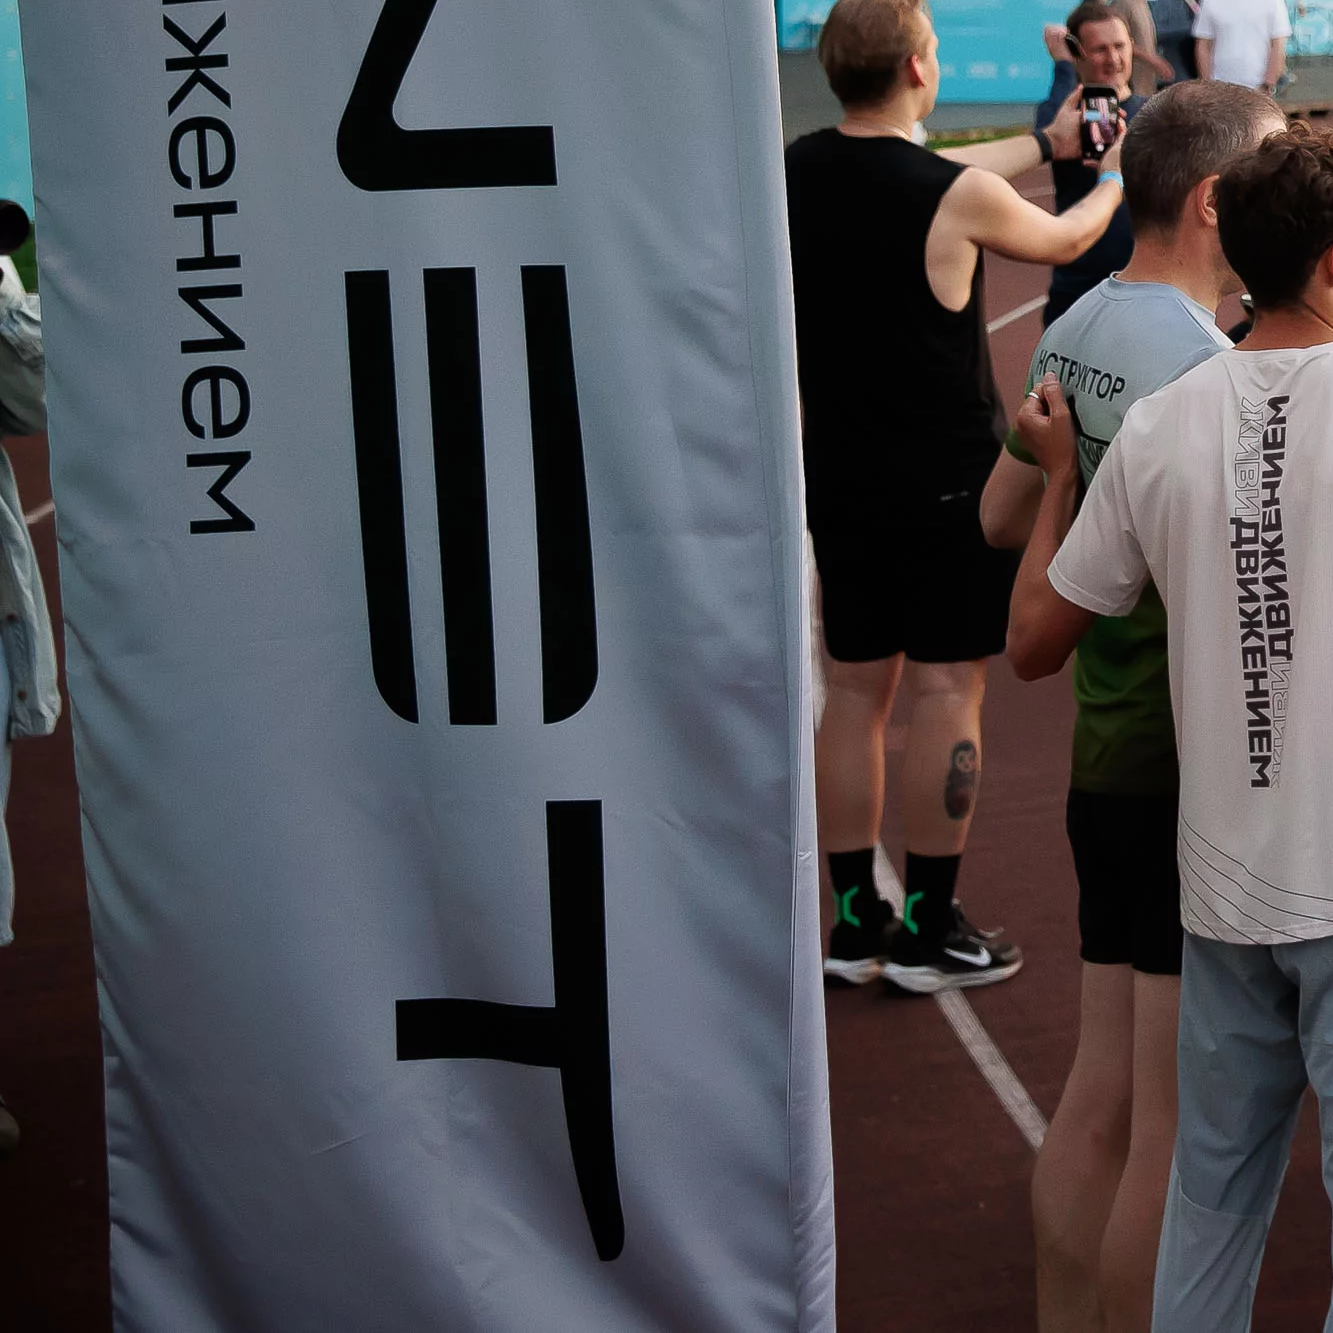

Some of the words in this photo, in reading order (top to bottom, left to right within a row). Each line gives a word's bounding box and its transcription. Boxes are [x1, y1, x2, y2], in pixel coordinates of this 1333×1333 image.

[1036, 349, 1126, 403] НСТРУКТОР
[1234, 396, 1266, 516] ЖИВИ
[1261, 395, 1295, 661] ДВИЖЕНИЕМ
[1229, 517, 1272, 789] ДВИЖЕНИЕМ
